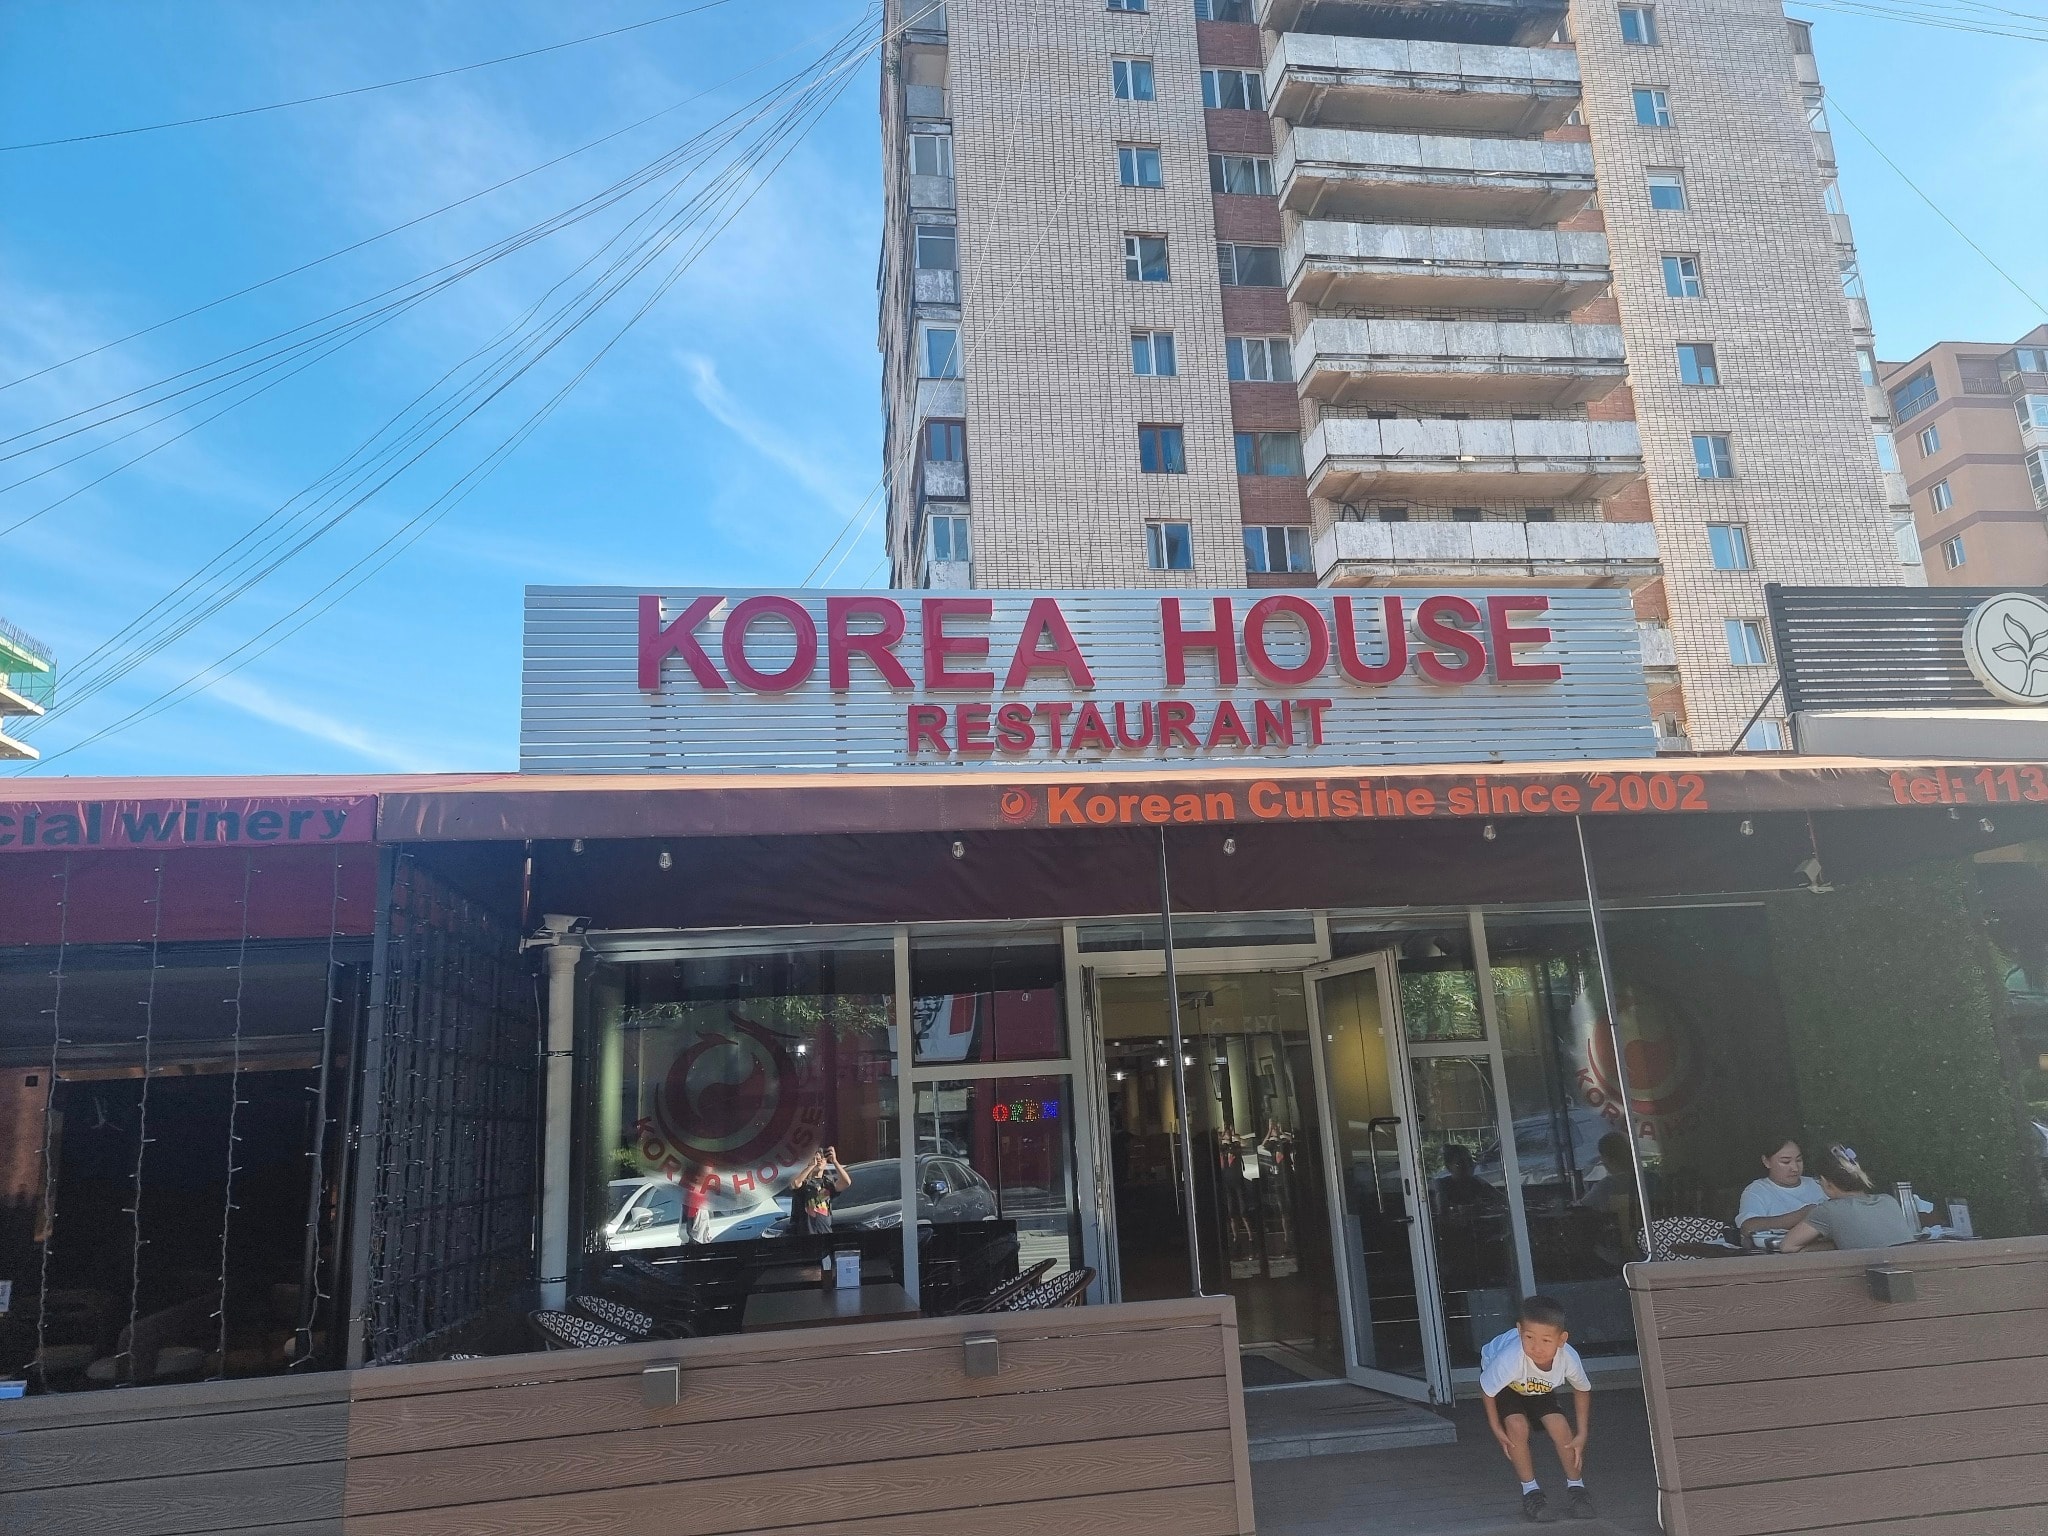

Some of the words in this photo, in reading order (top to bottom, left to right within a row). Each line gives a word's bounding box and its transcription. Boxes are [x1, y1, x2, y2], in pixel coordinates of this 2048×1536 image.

[638, 595, 1096, 696] KOREA
[1160, 594, 1563, 688] HOUSE
[906, 699, 1331, 755] RESTAURANT
[121, 800, 347, 844] winery
[1048, 787, 1235, 824] Korean
[1248, 780, 1436, 818] Cuisine
[1447, 778, 1581, 816] since
[1589, 774, 1709, 813] 2002
[1888, 768, 1968, 804] tel:
[1975, 767, 2048, 802] 113
[992, 1100, 1058, 1122] OPEN
[1576, 1068, 1657, 1141] KORA
[731, 1106, 823, 1195] HOUSE
[1526, 1382, 1553, 1393] GUYS
